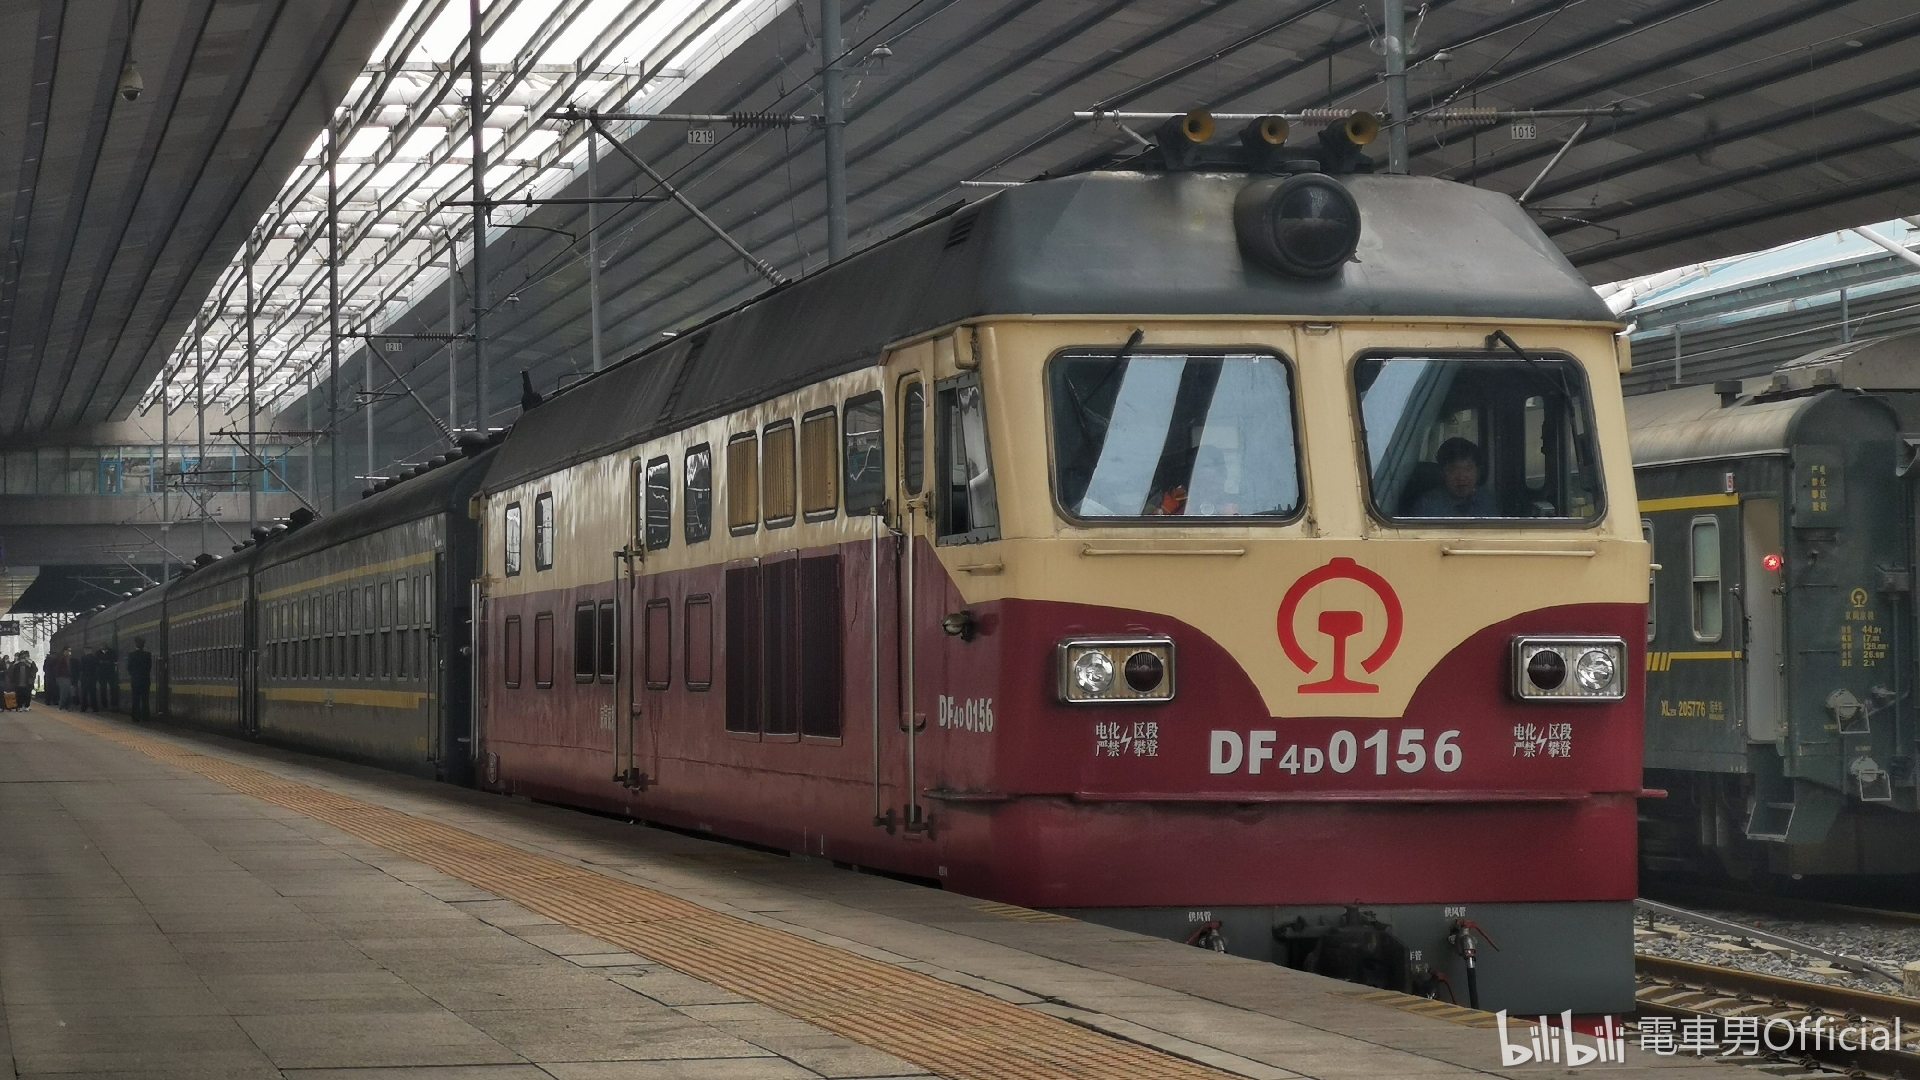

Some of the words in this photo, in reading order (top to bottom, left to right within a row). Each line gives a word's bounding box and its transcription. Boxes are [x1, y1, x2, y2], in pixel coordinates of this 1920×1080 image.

[689, 130, 713, 143] 1219
[1513, 126, 1536, 138] 1019
[1679, 701, 1706, 717] 205776
